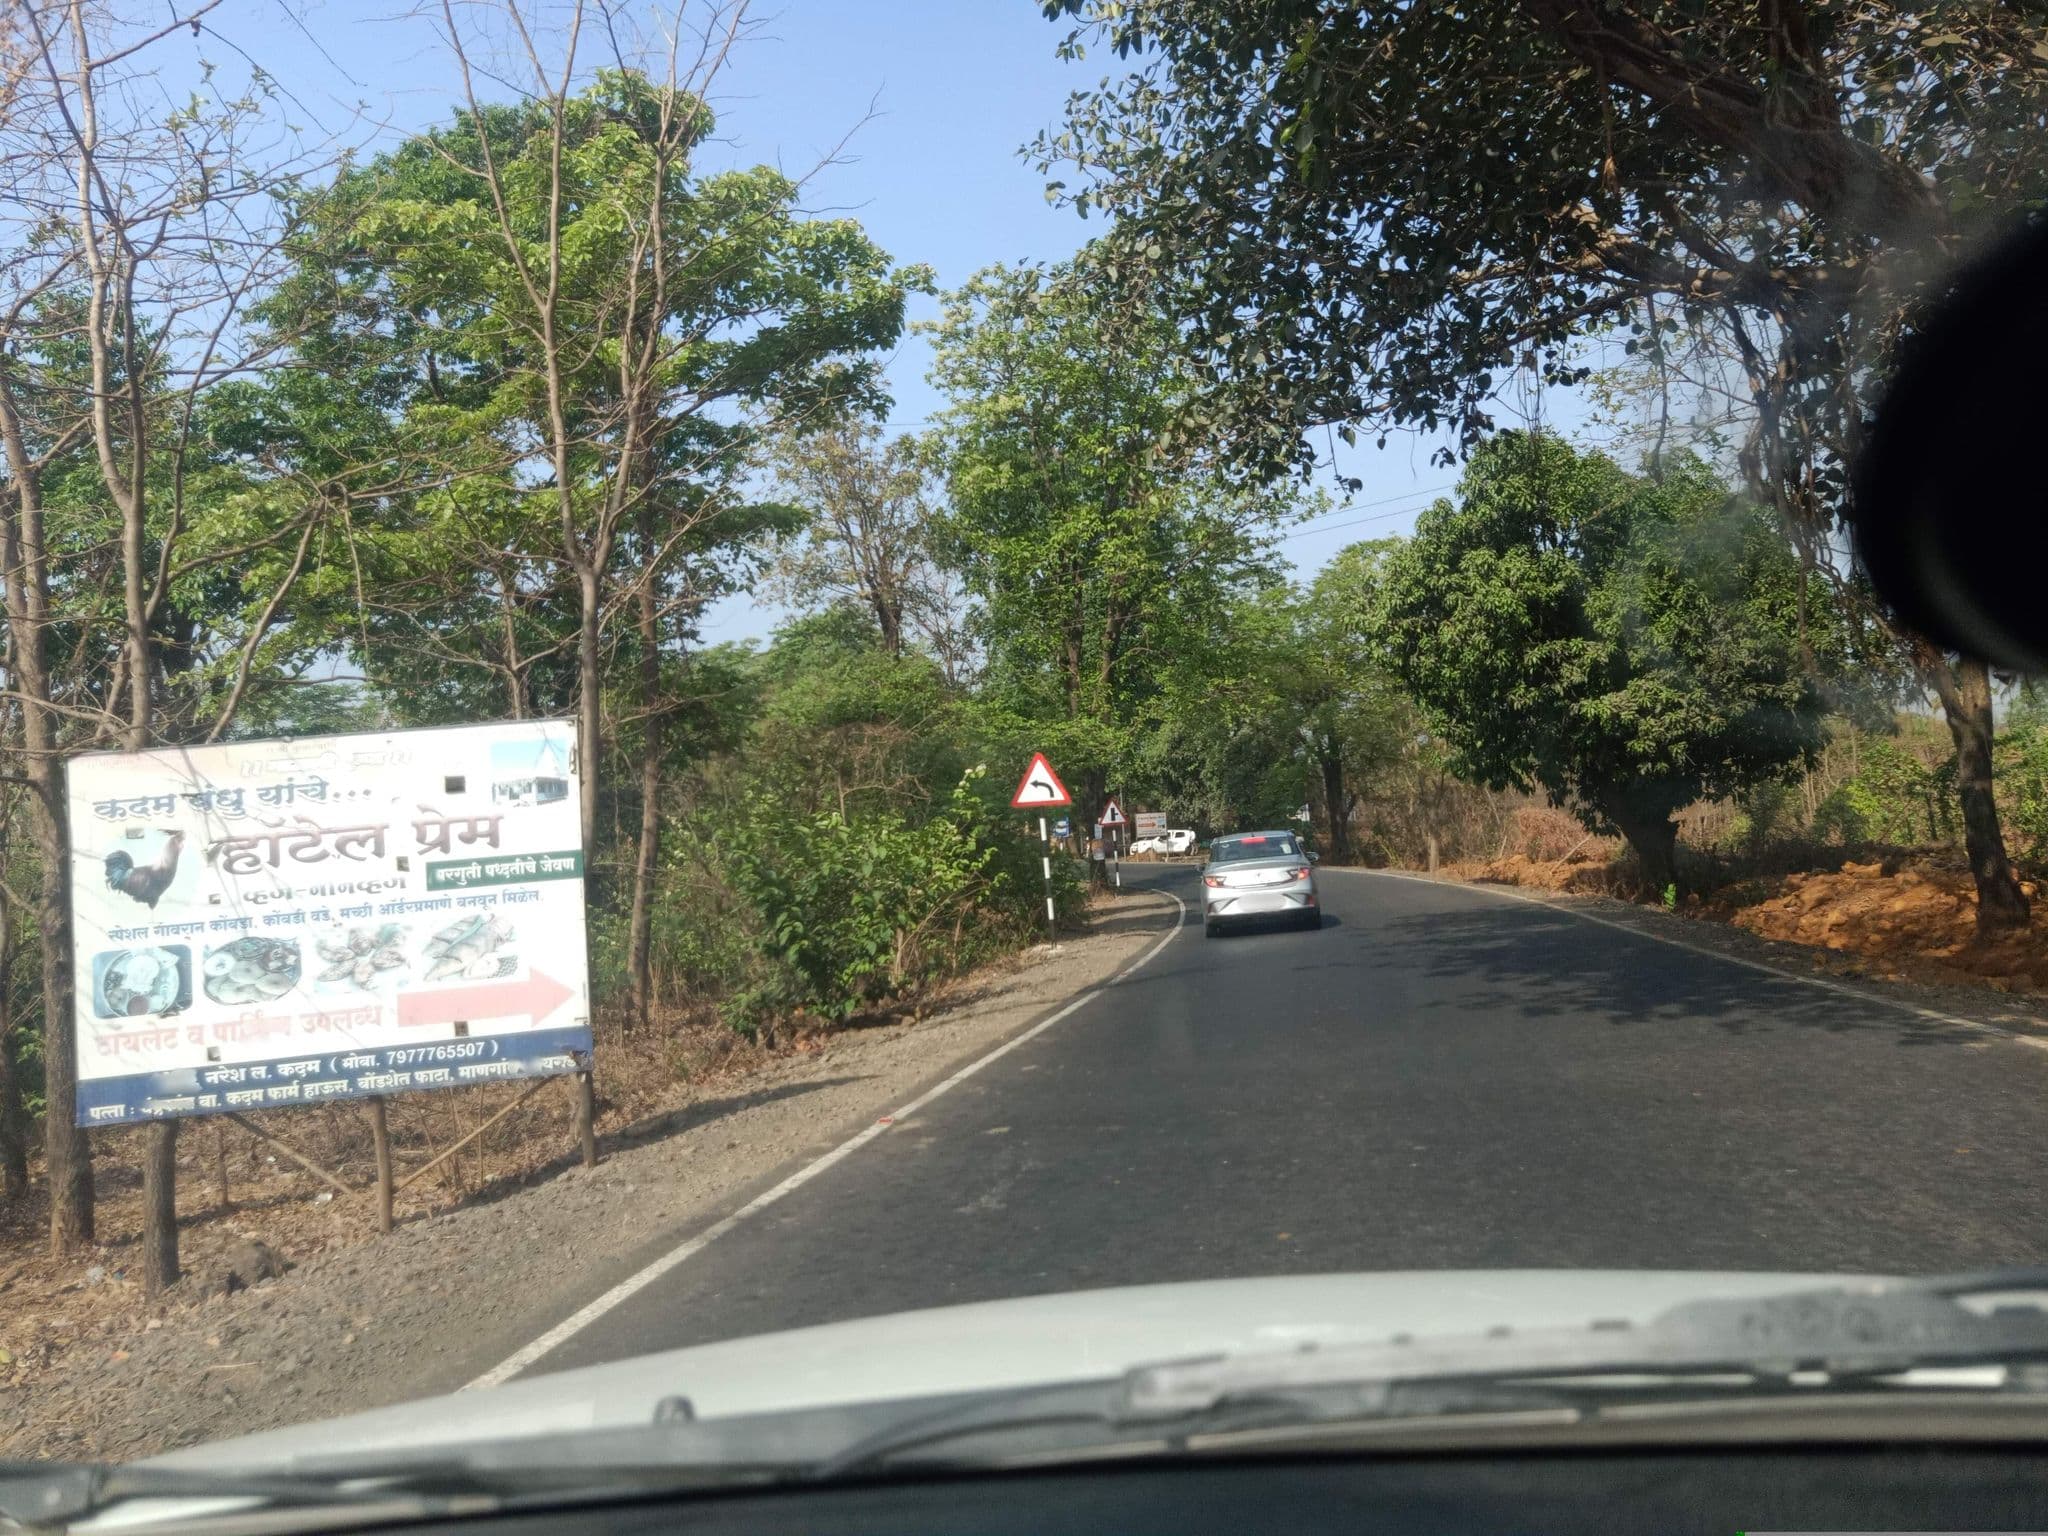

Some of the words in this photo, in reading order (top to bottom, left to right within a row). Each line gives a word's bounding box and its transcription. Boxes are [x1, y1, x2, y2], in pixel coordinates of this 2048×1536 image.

[93, 793, 177, 817] कदम
[217, 815, 389, 874] हॉटेल
[412, 804, 503, 855] प्रेम
[540, 855, 575, 872] जेवण
[96, 1021, 178, 1056] टॉयलेट
[187, 1025, 205, 1046] व
[300, 1004, 384, 1033] उपलब्ध
[205, 1065, 247, 1084] नरेश
[277, 1060, 321, 1078] कदम
[387, 1042, 485, 1064] 7977765507
[90, 1103, 126, 1120] पत्ता
[226, 1088, 263, 1105] कदम
[267, 1079, 299, 1099] फार्म
